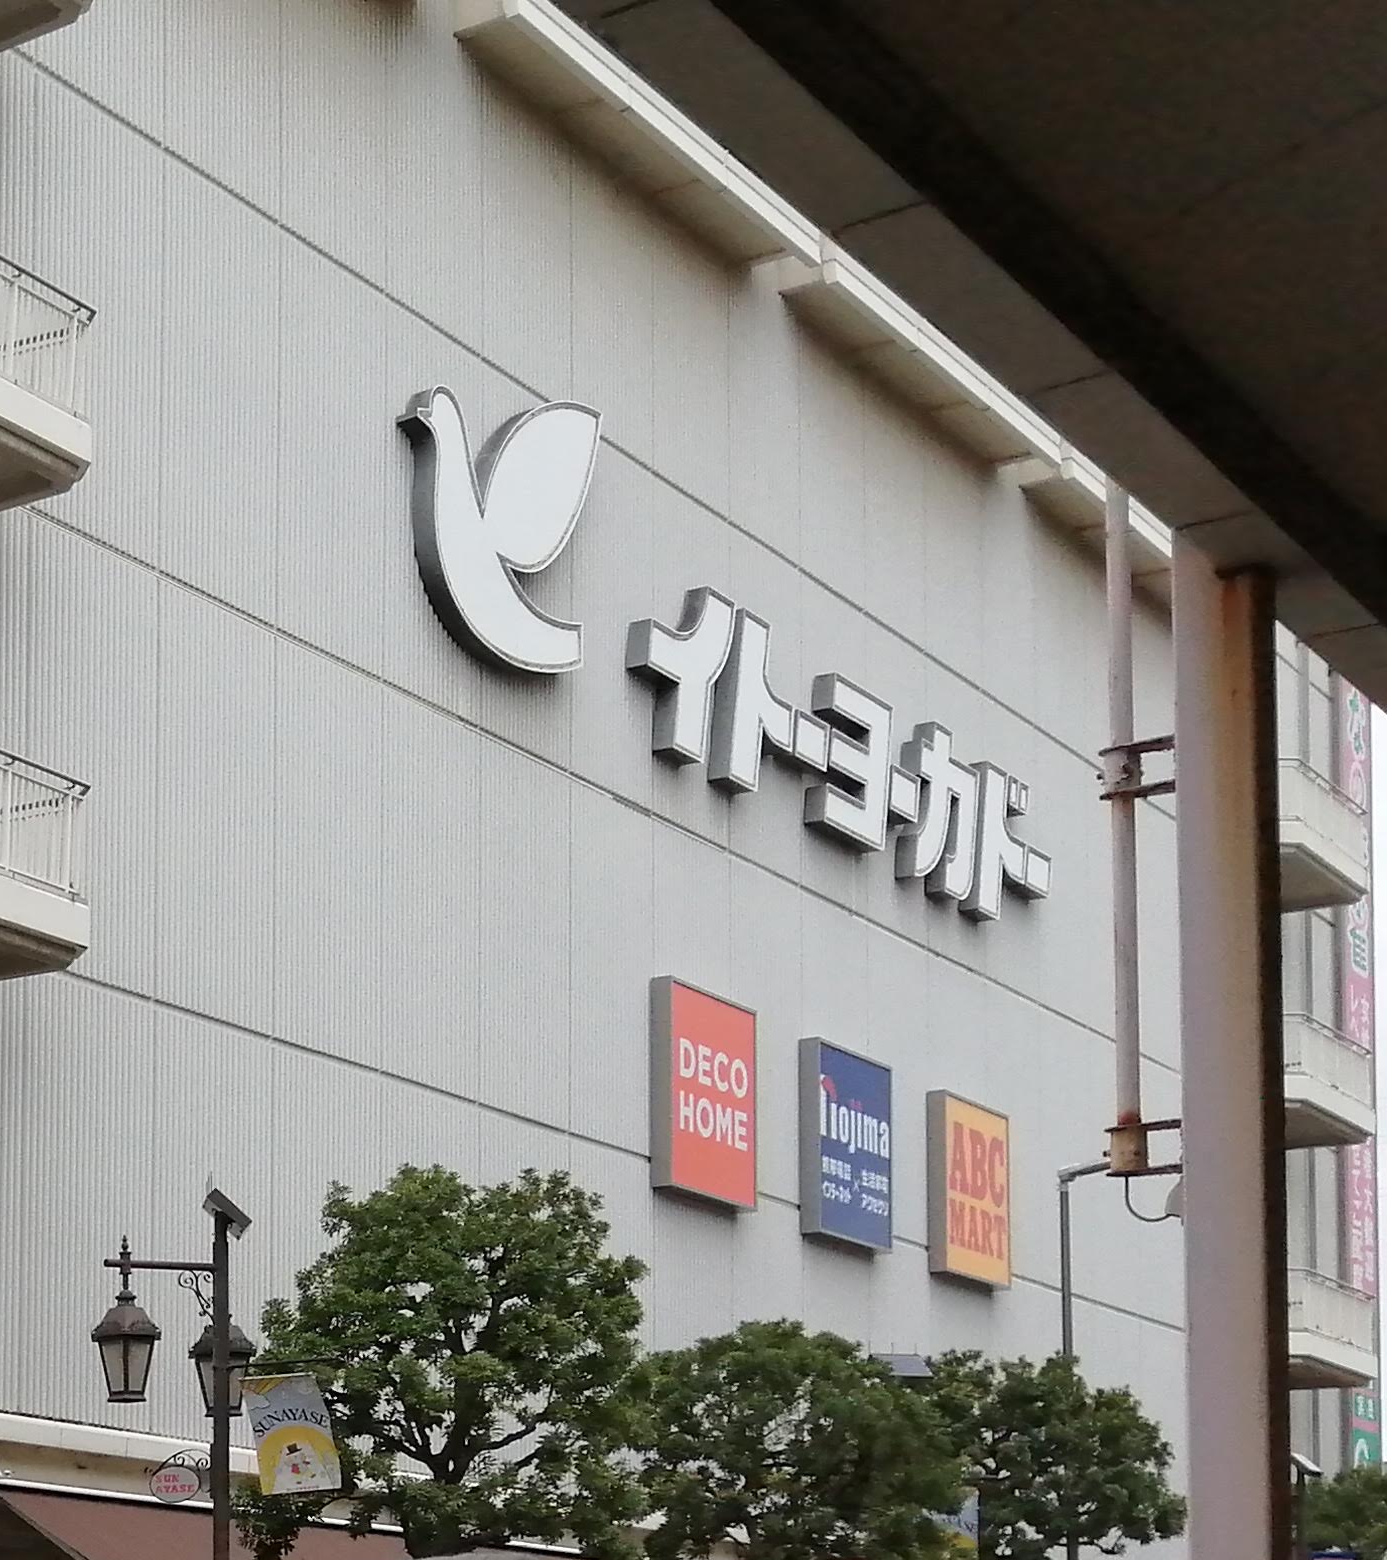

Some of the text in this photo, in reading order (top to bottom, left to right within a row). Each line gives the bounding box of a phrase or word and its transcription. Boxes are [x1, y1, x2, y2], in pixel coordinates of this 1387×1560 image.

[679, 1037, 749, 1099] DECO
[679, 1091, 749, 1152] HOME
[949, 1121, 1005, 1207] ABC
[948, 1198, 1006, 1261] MART
[253, 1408, 330, 1438] SUNAYASE
[155, 1473, 180, 1483] SUN
[155, 1484, 195, 1494] AYASE
